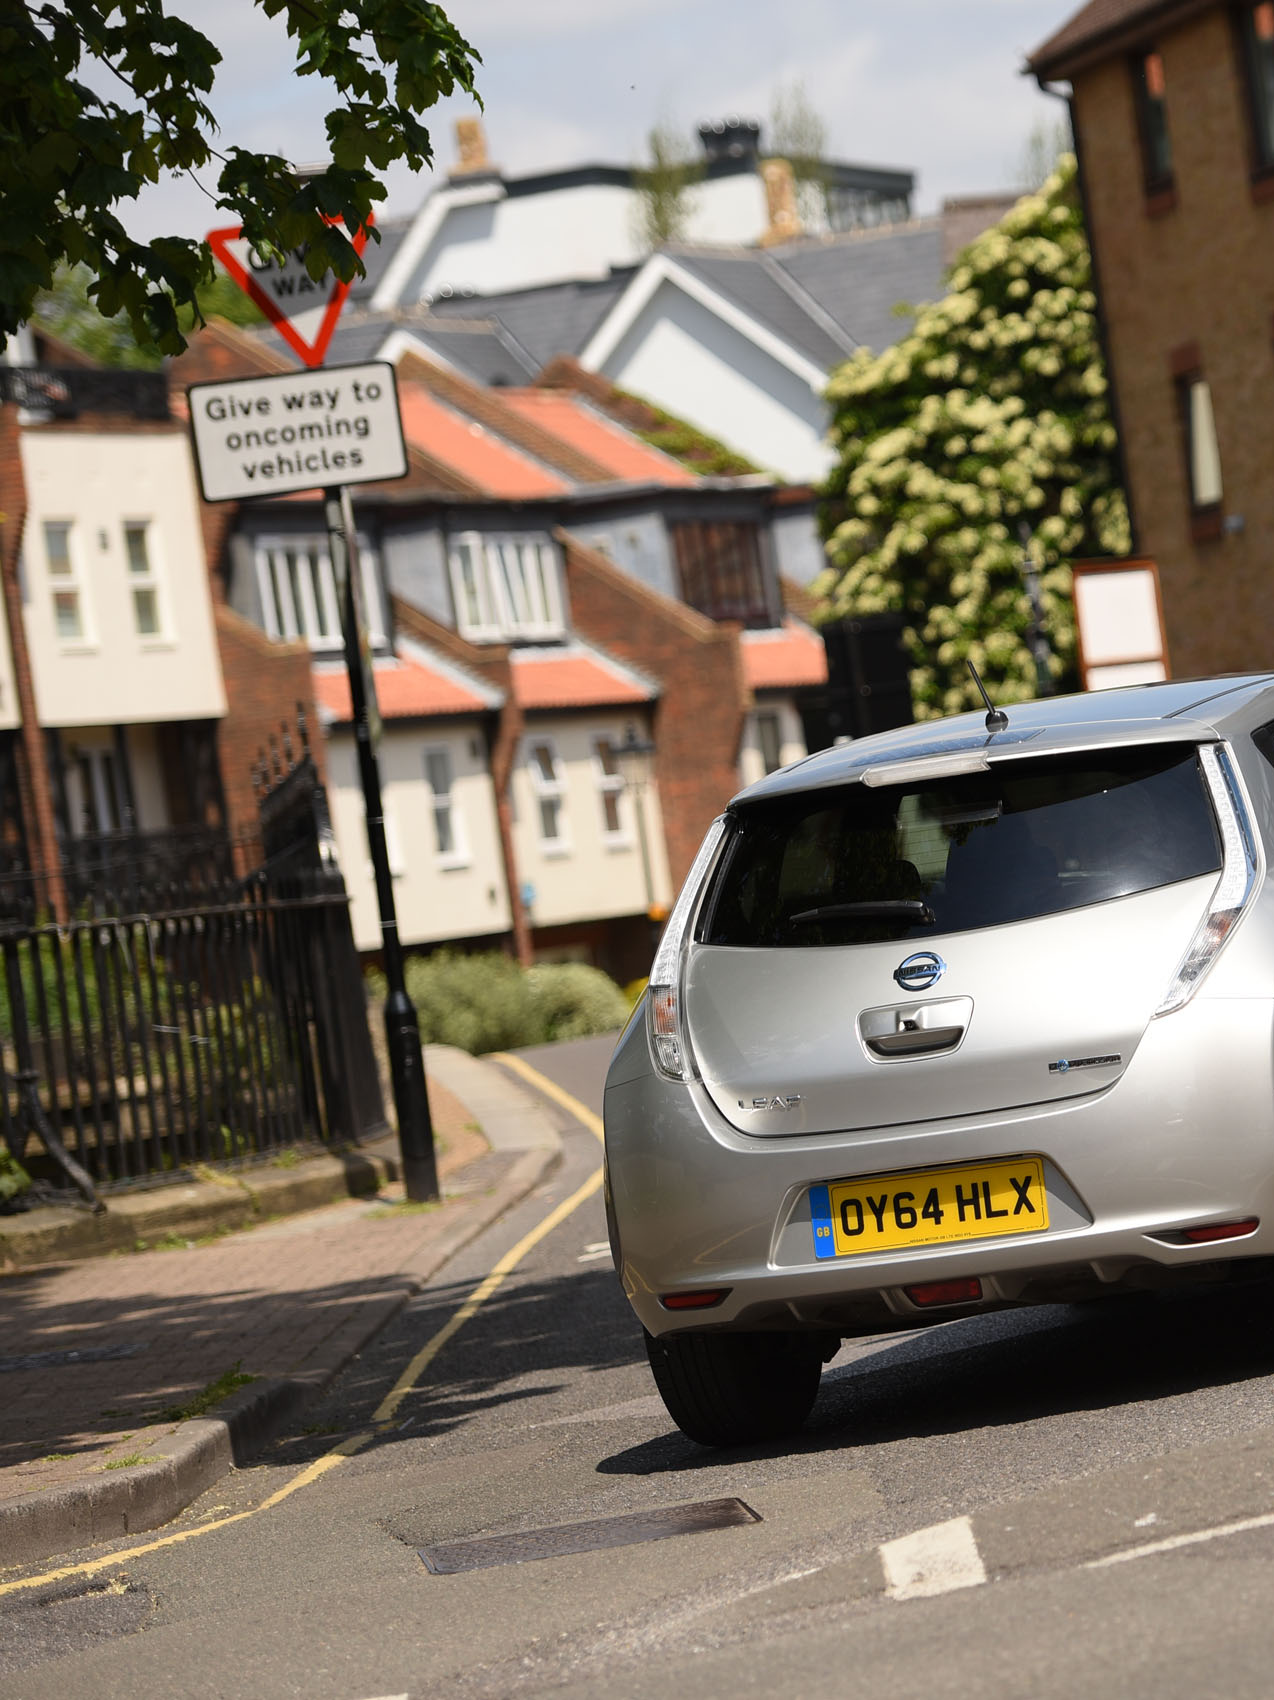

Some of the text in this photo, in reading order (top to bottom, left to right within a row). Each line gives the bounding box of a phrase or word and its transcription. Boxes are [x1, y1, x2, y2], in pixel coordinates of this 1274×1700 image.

[205, 381, 382, 422] Give way to
[226, 416, 371, 450] oncoming
[242, 449, 364, 480] vehicles
[897, 964, 941, 978] NISSAN
[840, 1176, 1035, 1236] OY64 HLX
[816, 1226, 831, 1238] GB
